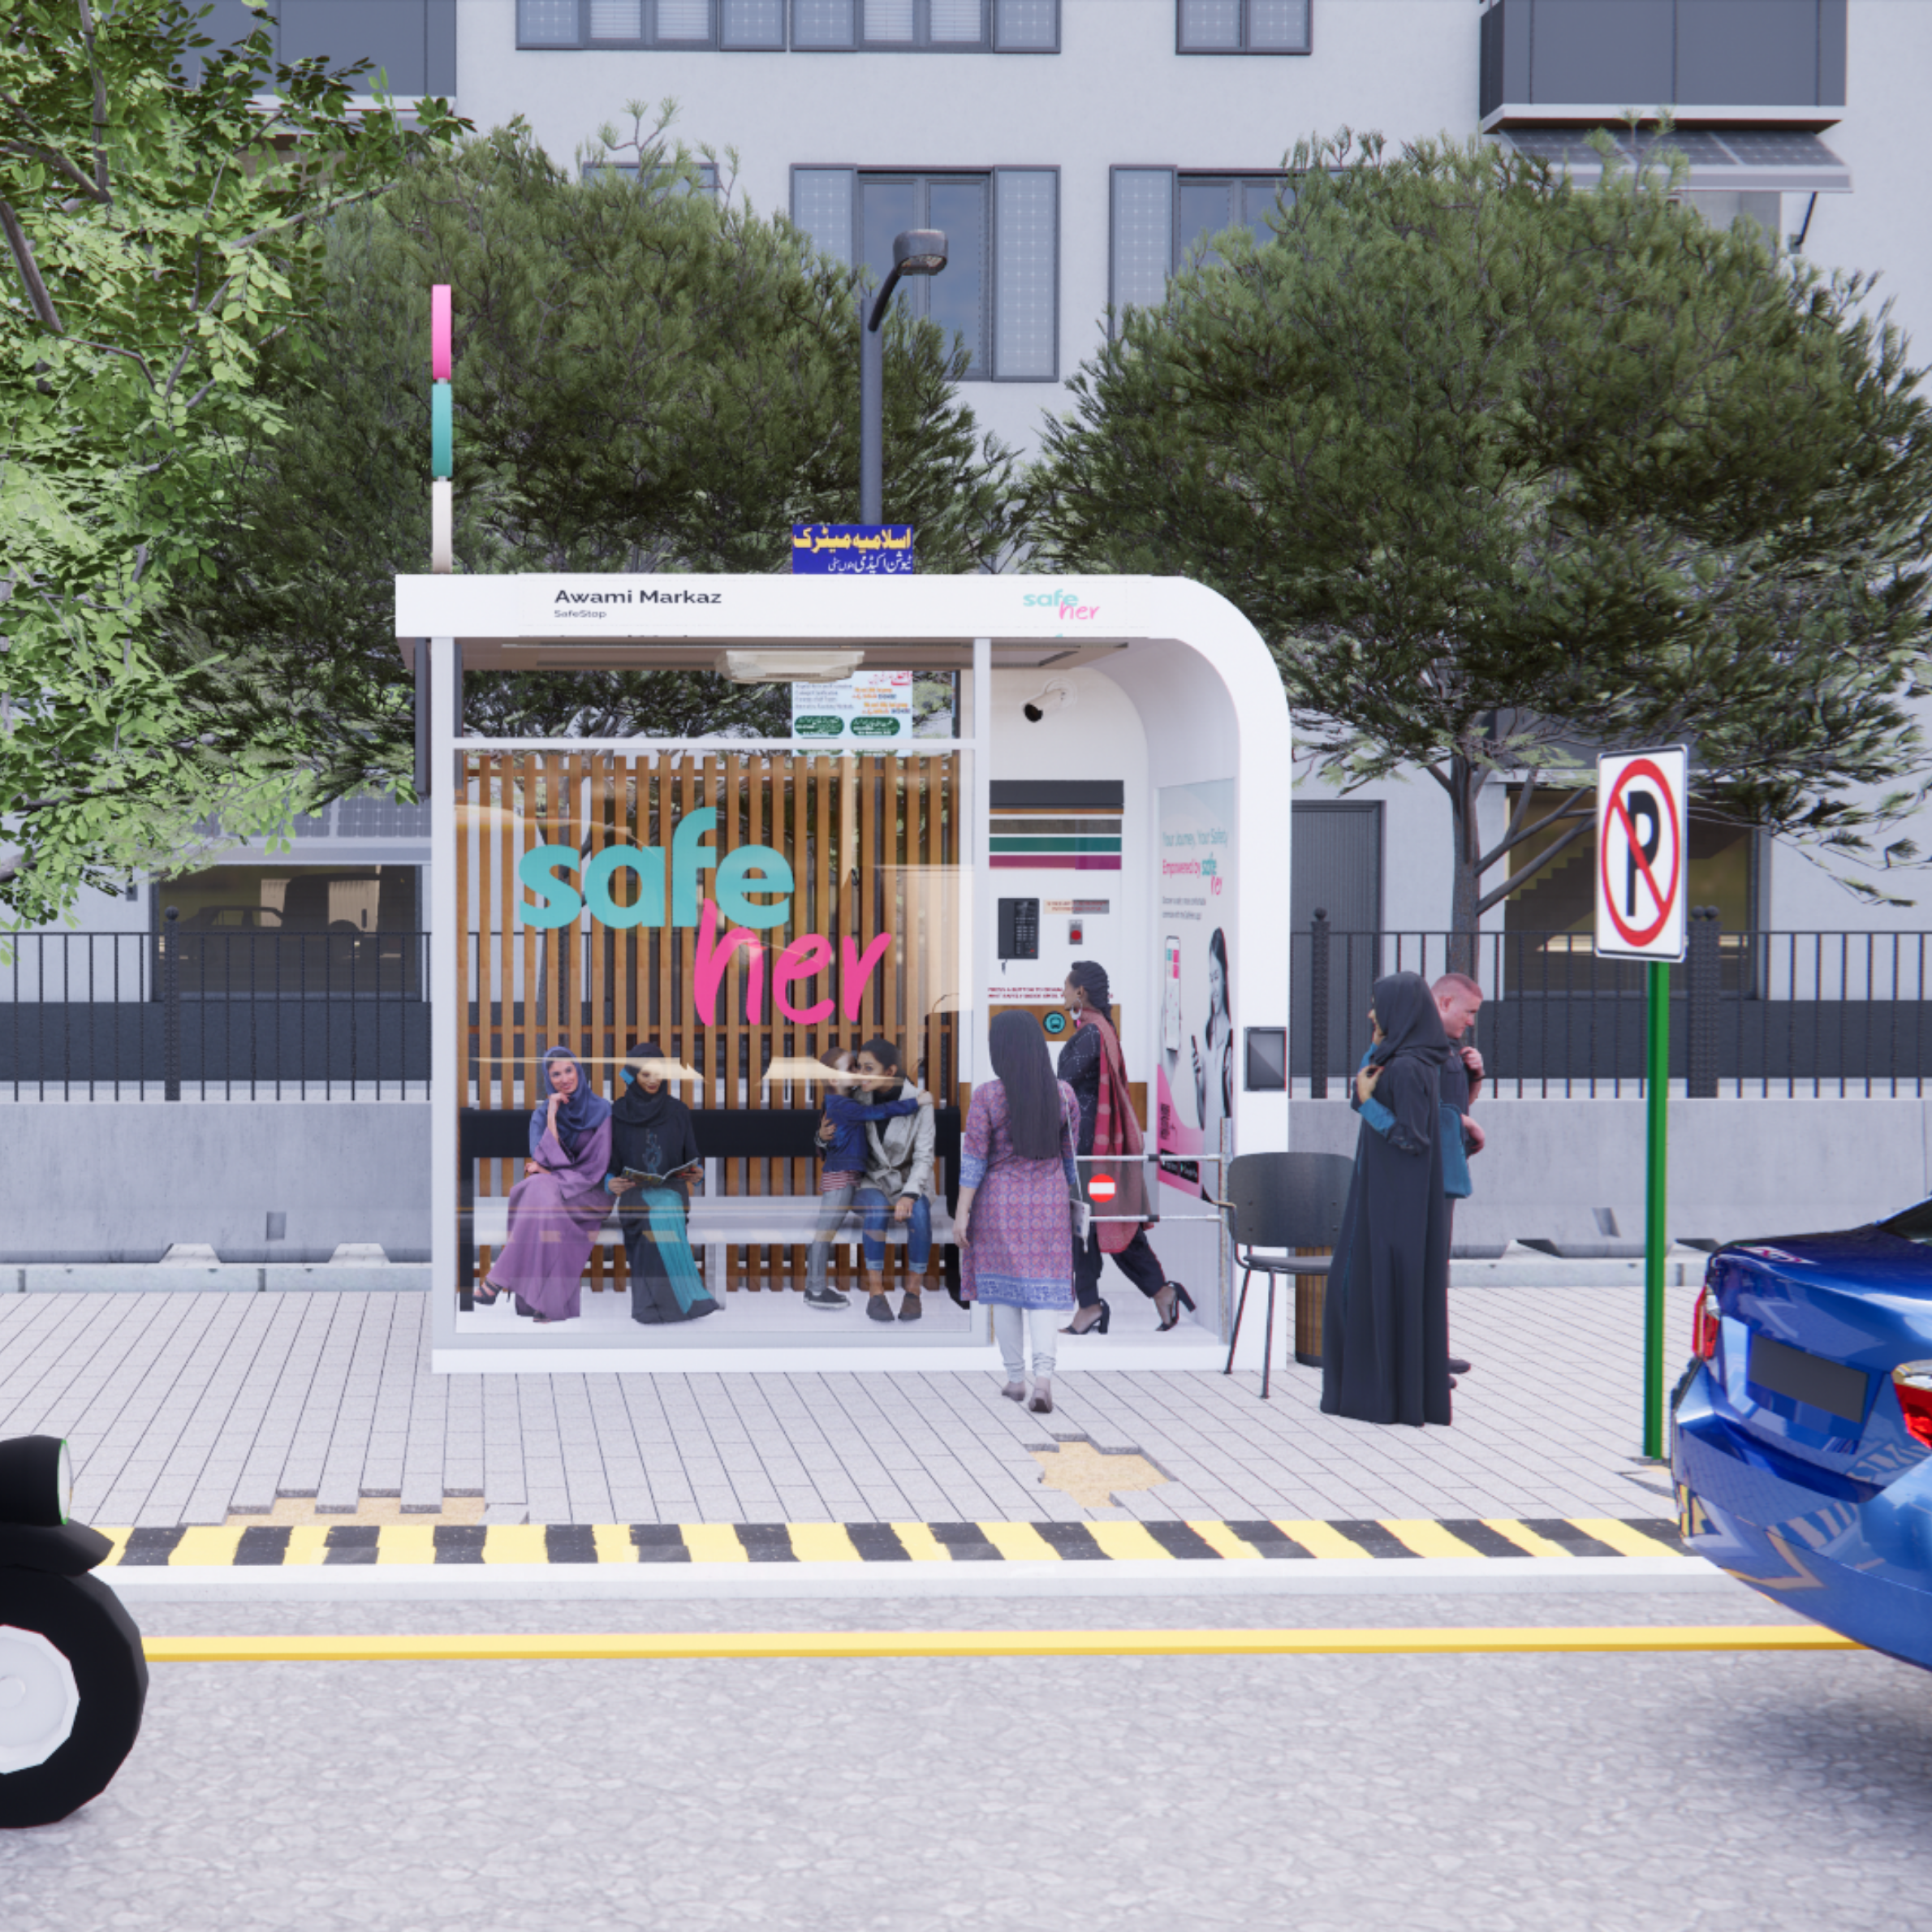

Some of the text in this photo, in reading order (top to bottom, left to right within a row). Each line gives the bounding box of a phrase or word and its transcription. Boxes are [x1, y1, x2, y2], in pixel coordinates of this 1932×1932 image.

[793, 526, 911, 554] اسلامیہ میٹرک
[554, 589, 722, 604] Awami Markaz
[1023, 589, 1078, 607] safe
[554, 610, 607, 619] SafeStop
[1059, 602, 1100, 620] her
[1626, 790, 1661, 917] P
[518, 806, 796, 929] safe
[694, 897, 892, 1027] her
